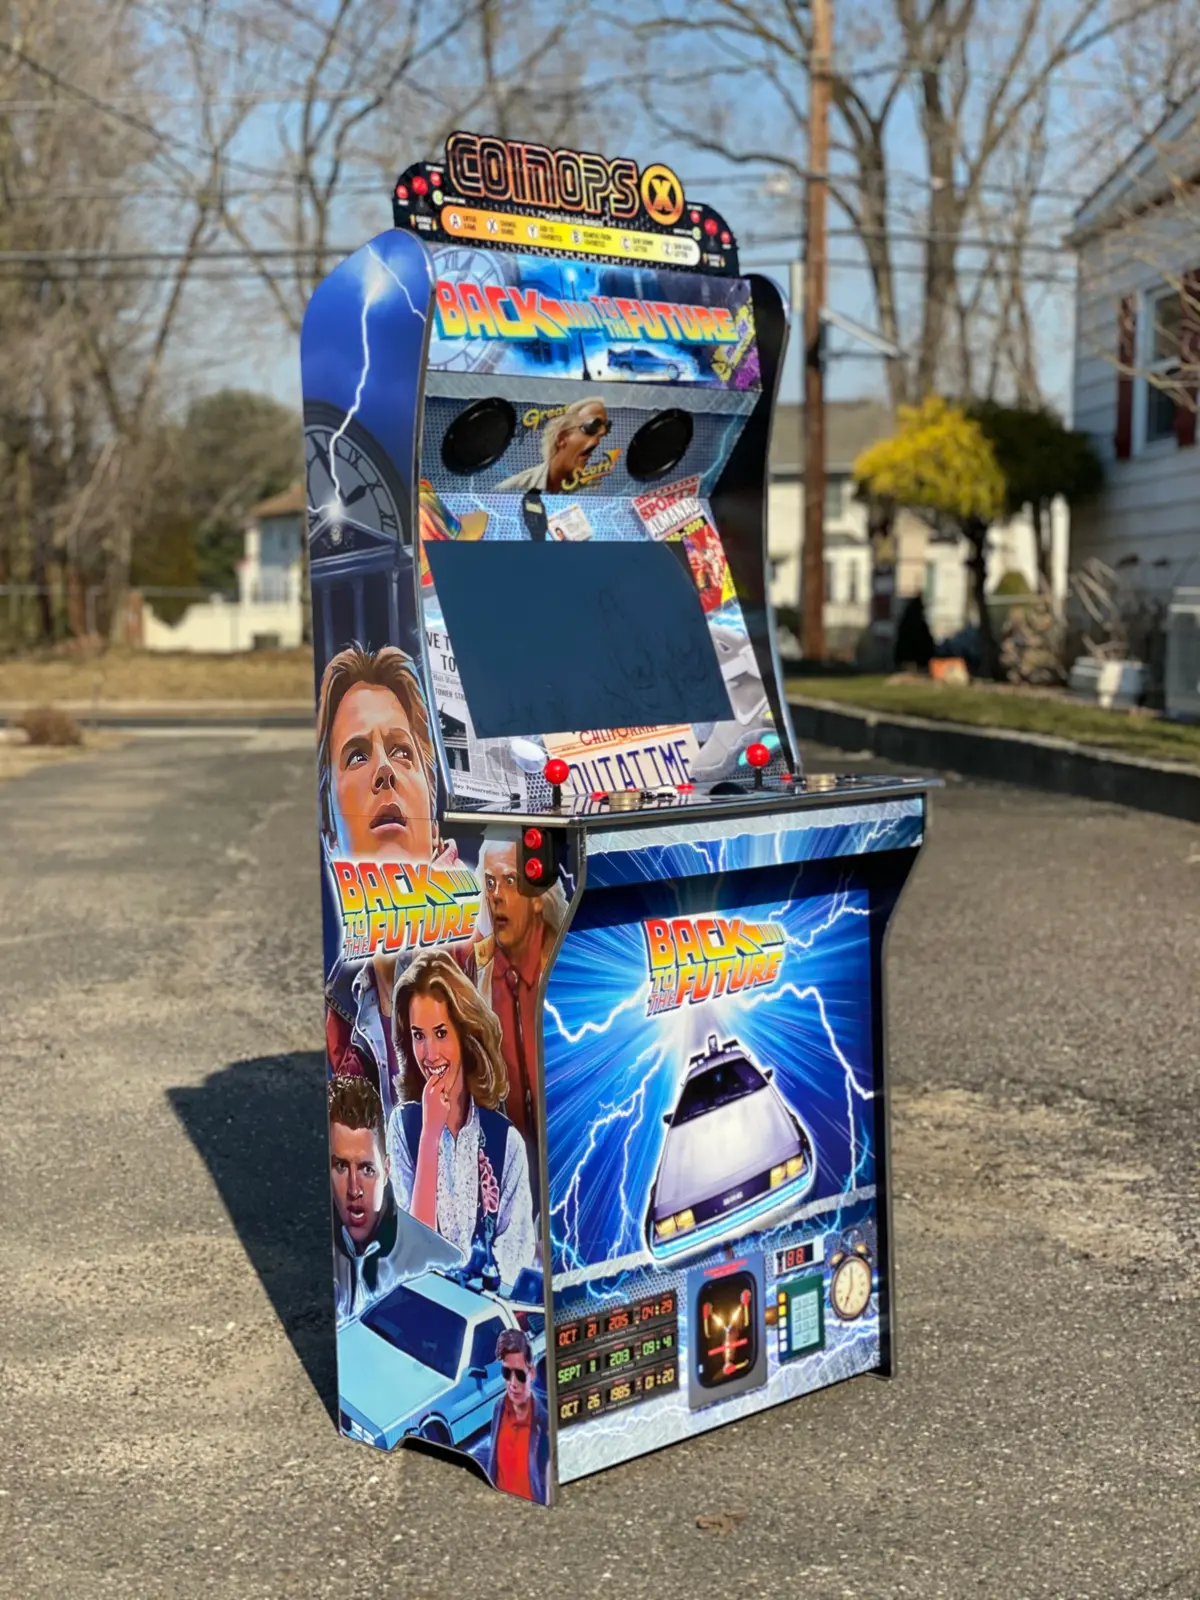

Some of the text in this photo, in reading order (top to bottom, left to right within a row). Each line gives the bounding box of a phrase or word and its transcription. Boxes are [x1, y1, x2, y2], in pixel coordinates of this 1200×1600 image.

[434, 279, 573, 342] BACK
[613, 297, 739, 345] FUTURE
[330, 861, 456, 916] BACK
[344, 902, 480, 954] TO FUTURE
[641, 919, 764, 972] BACK
[343, 936, 369, 962] THE
[650, 950, 784, 1004] TO FUTURE
[647, 988, 678, 1017] THE
[559, 1328, 577, 1347] OCT
[558, 1363, 582, 1384] SEPT
[560, 1400, 580, 1419] OCT
[587, 1393, 601, 1410] 26
